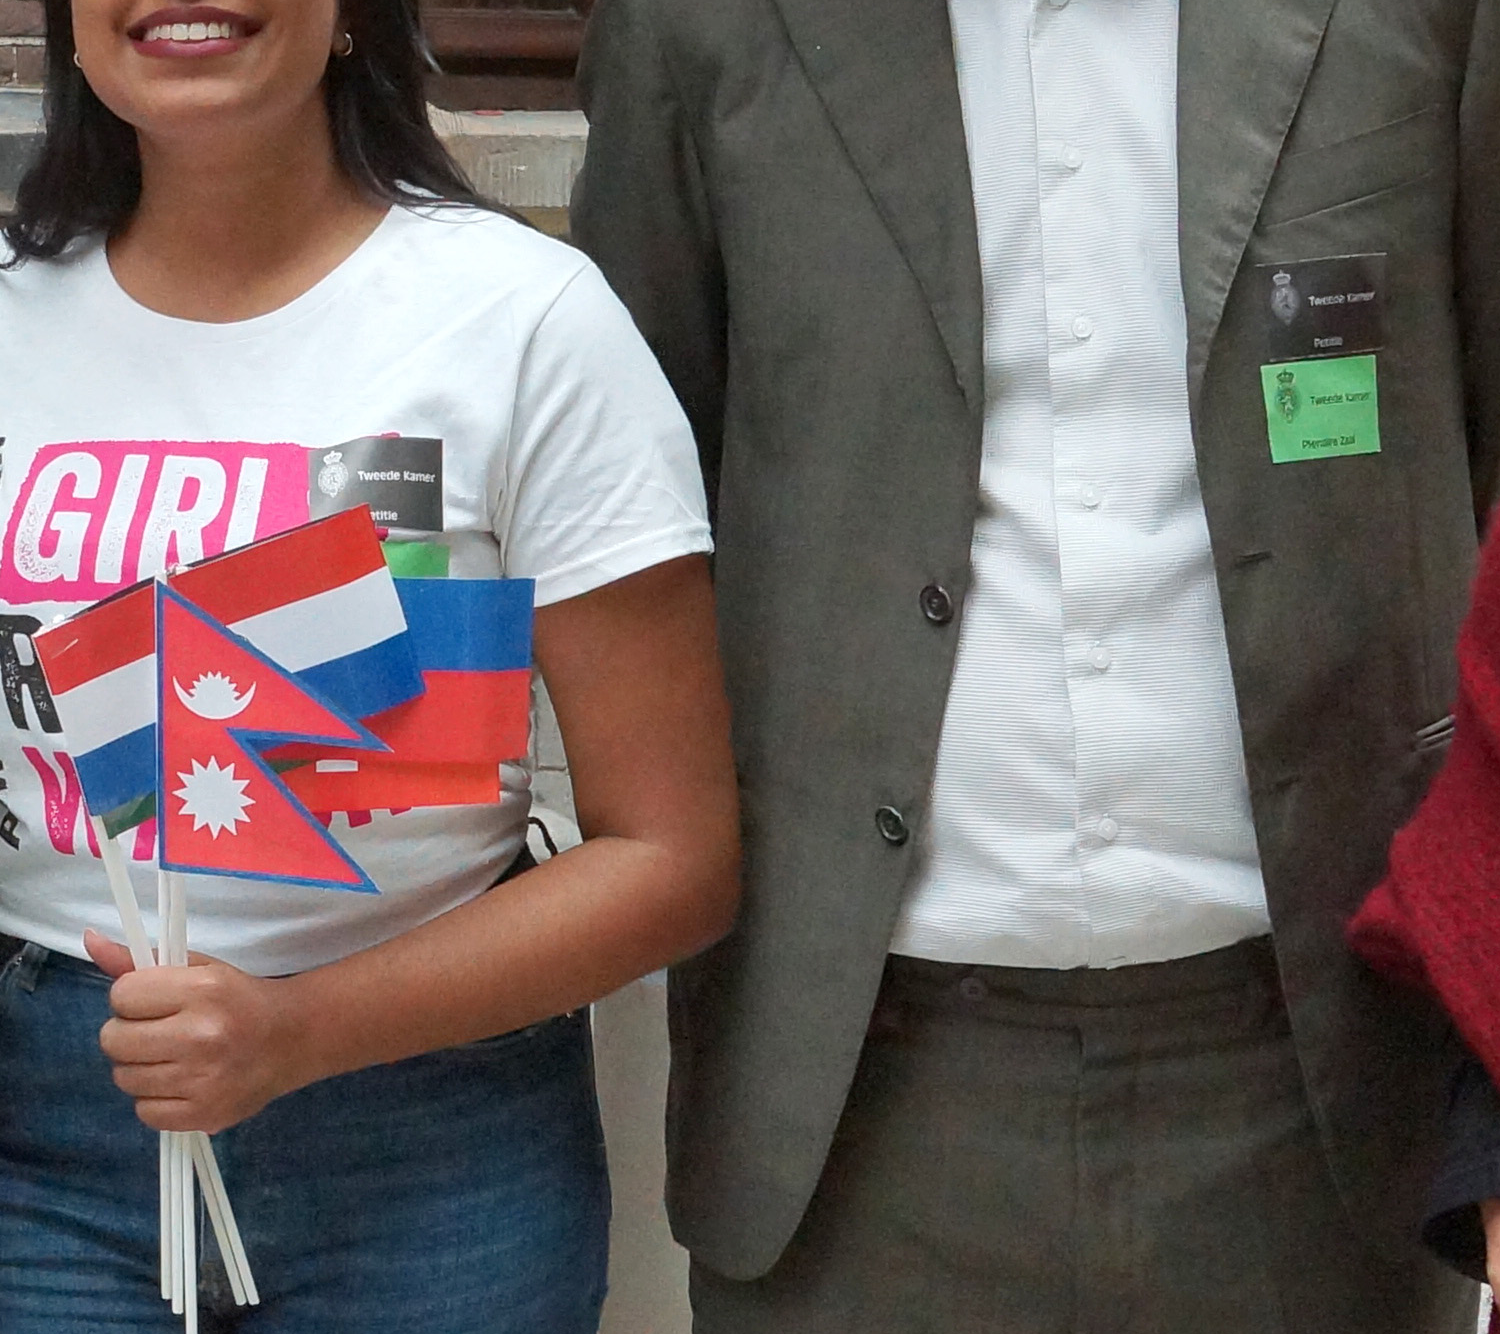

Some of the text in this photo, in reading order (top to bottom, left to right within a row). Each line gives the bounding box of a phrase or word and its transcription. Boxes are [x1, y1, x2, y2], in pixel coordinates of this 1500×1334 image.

[357, 470, 436, 483] Tweede Kamer
[12, 451, 268, 584] GIRL
[370, 510, 398, 521] etitie
